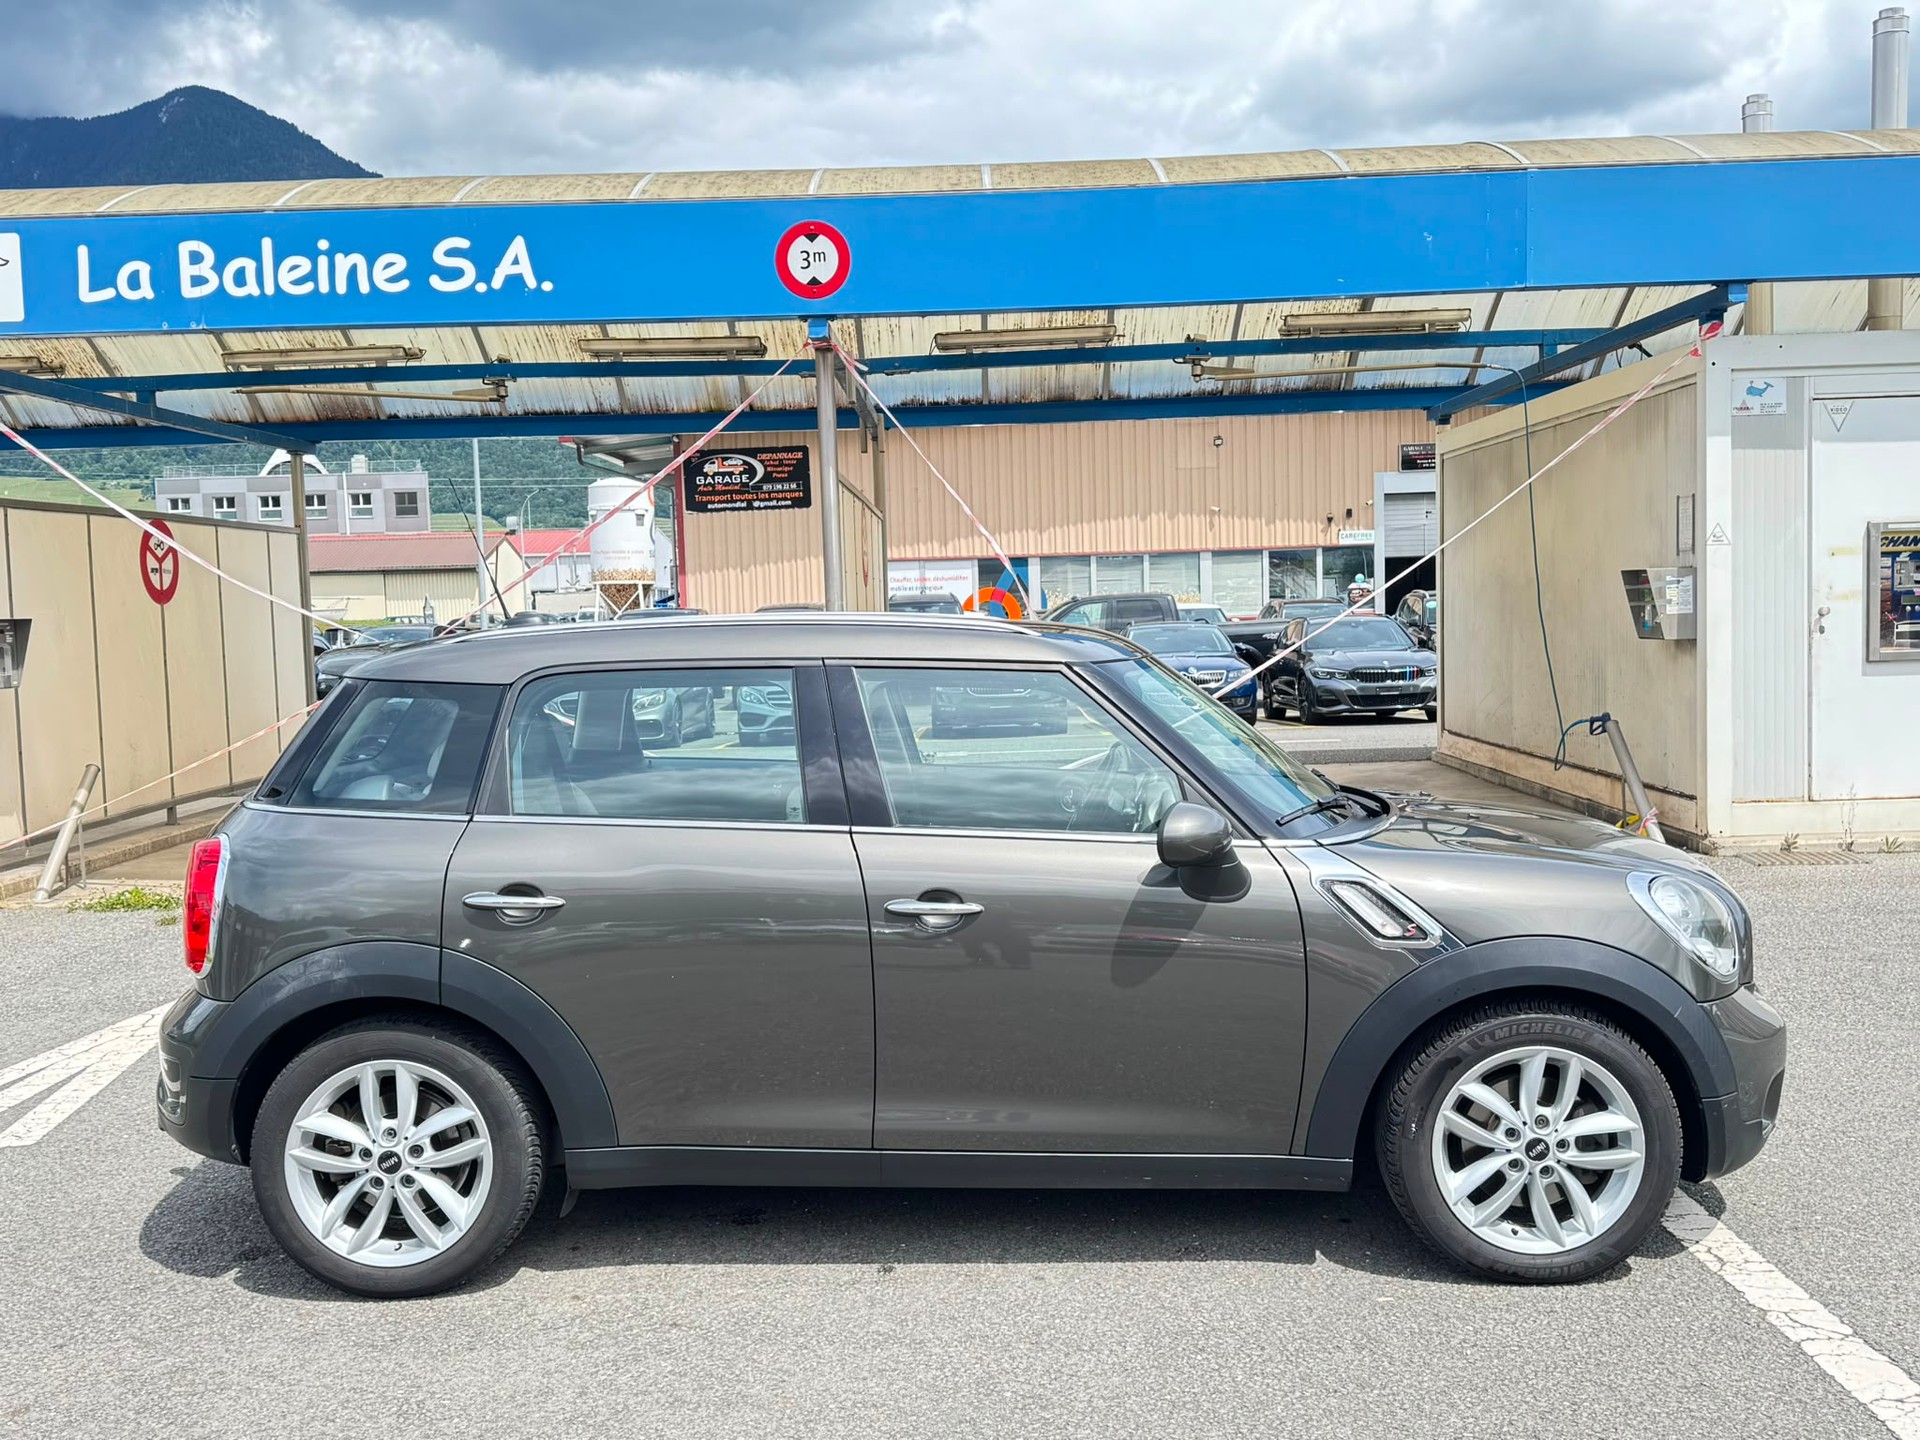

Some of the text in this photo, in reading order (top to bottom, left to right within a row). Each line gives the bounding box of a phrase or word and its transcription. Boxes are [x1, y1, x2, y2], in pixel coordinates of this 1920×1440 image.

[77, 235, 554, 303] La Baleine S.A.
[757, 452, 803, 460] DEPANNAGE
[696, 474, 750, 484] GARAGE
[694, 490, 803, 503] Transport toutes les marques
[707, 501, 747, 509] automondial
[1494, 1022, 1587, 1040] MICHELIN
[1528, 1141, 1547, 1158] MINI
[380, 1155, 399, 1170] MINI
